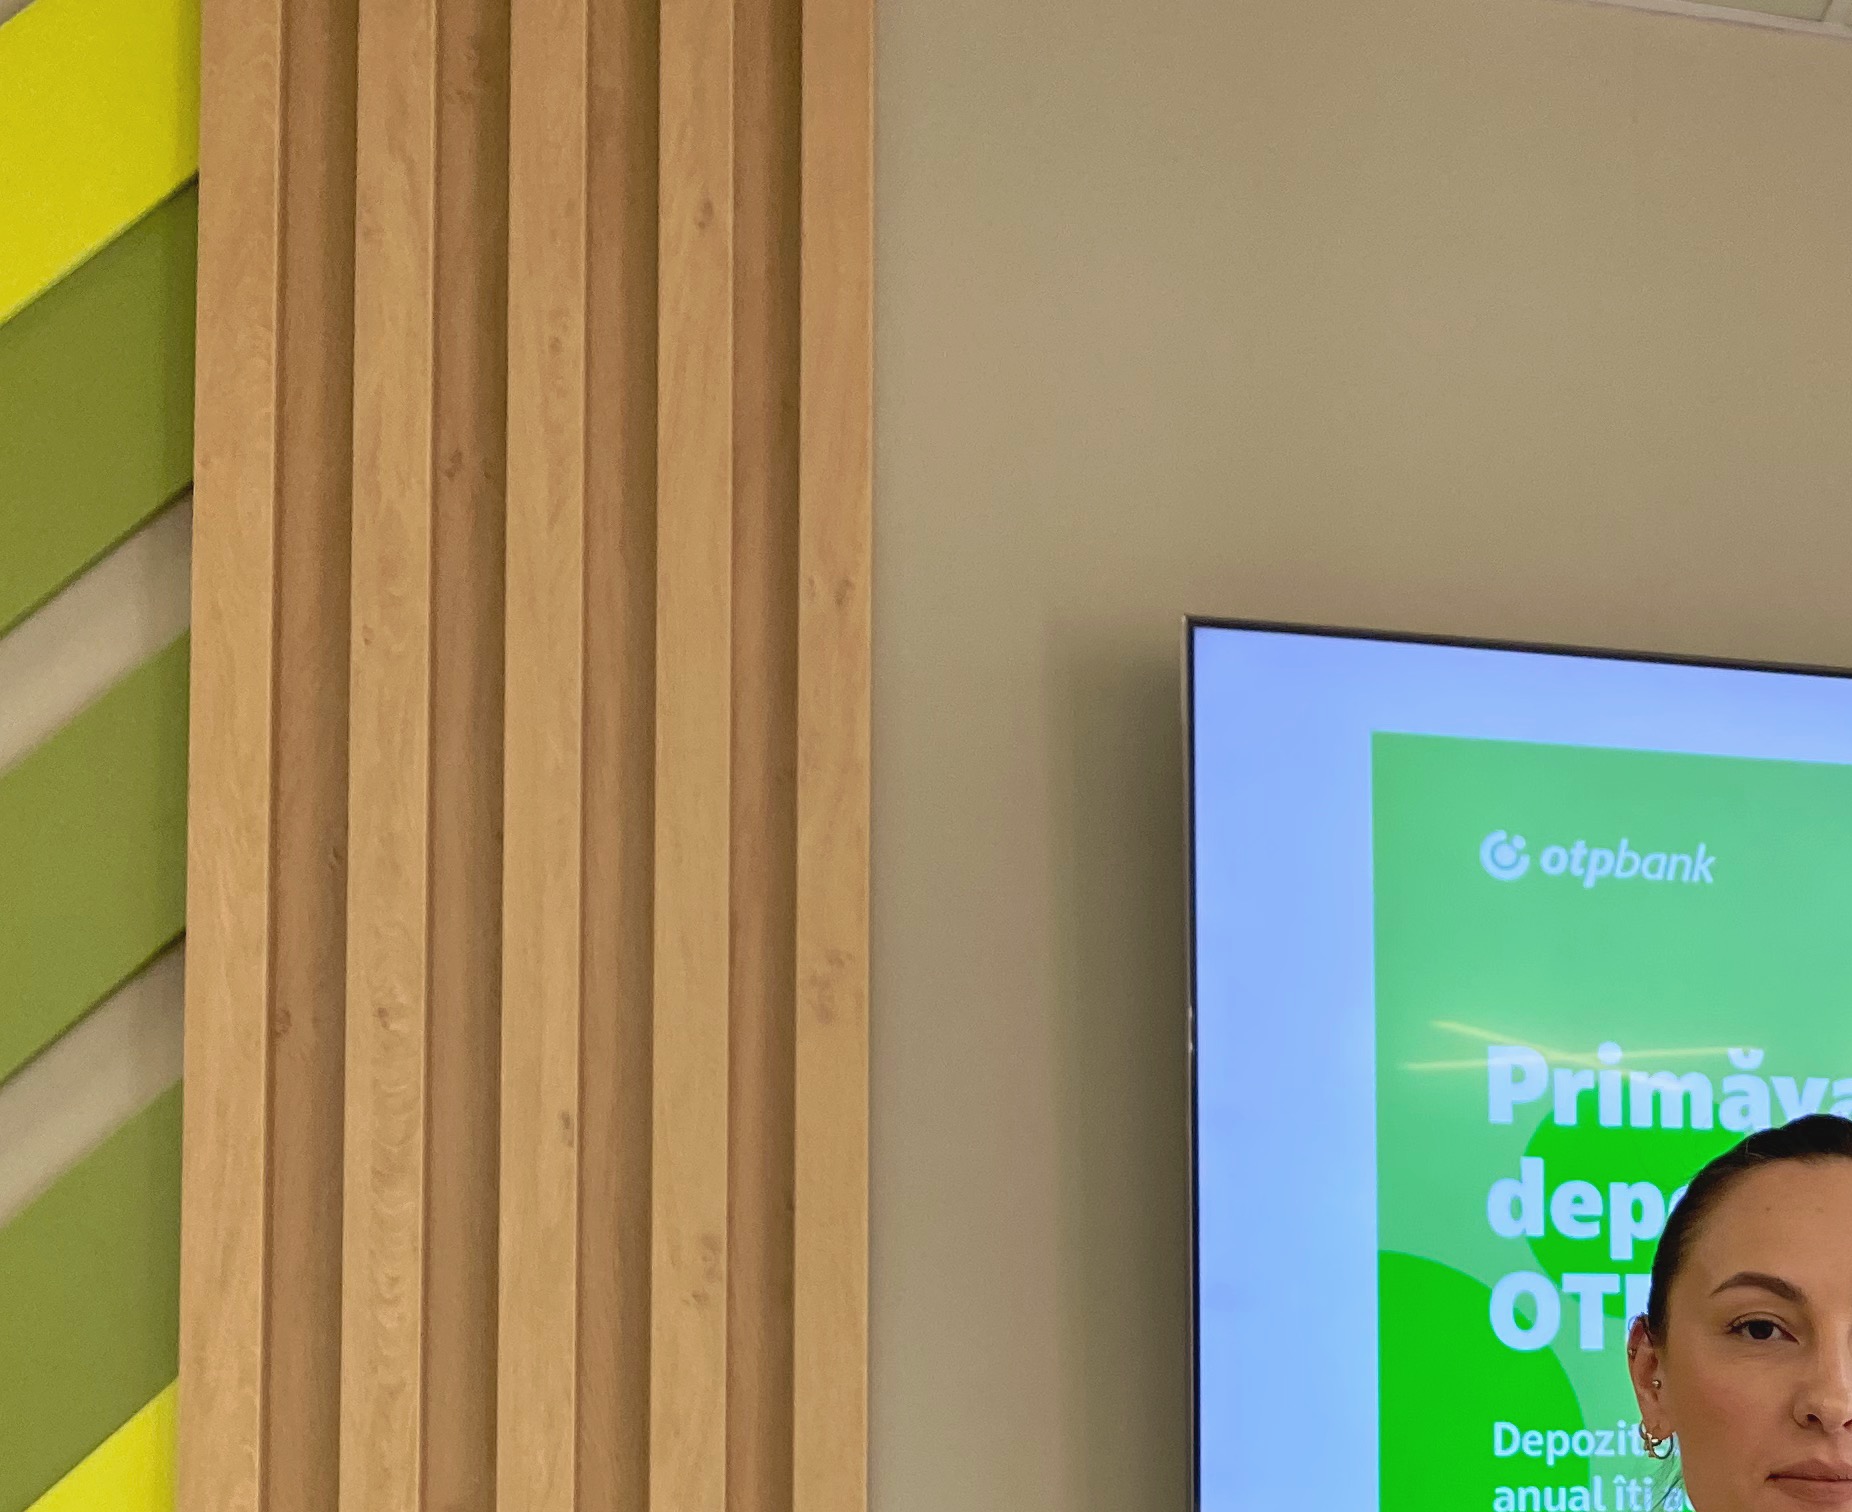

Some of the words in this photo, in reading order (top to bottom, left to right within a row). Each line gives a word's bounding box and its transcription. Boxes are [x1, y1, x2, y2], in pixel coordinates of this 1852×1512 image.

[1540, 837, 1716, 889] otpbank
[1493, 1419, 1682, 1467] Depozit
[1493, 1475, 1607, 1512] anual
